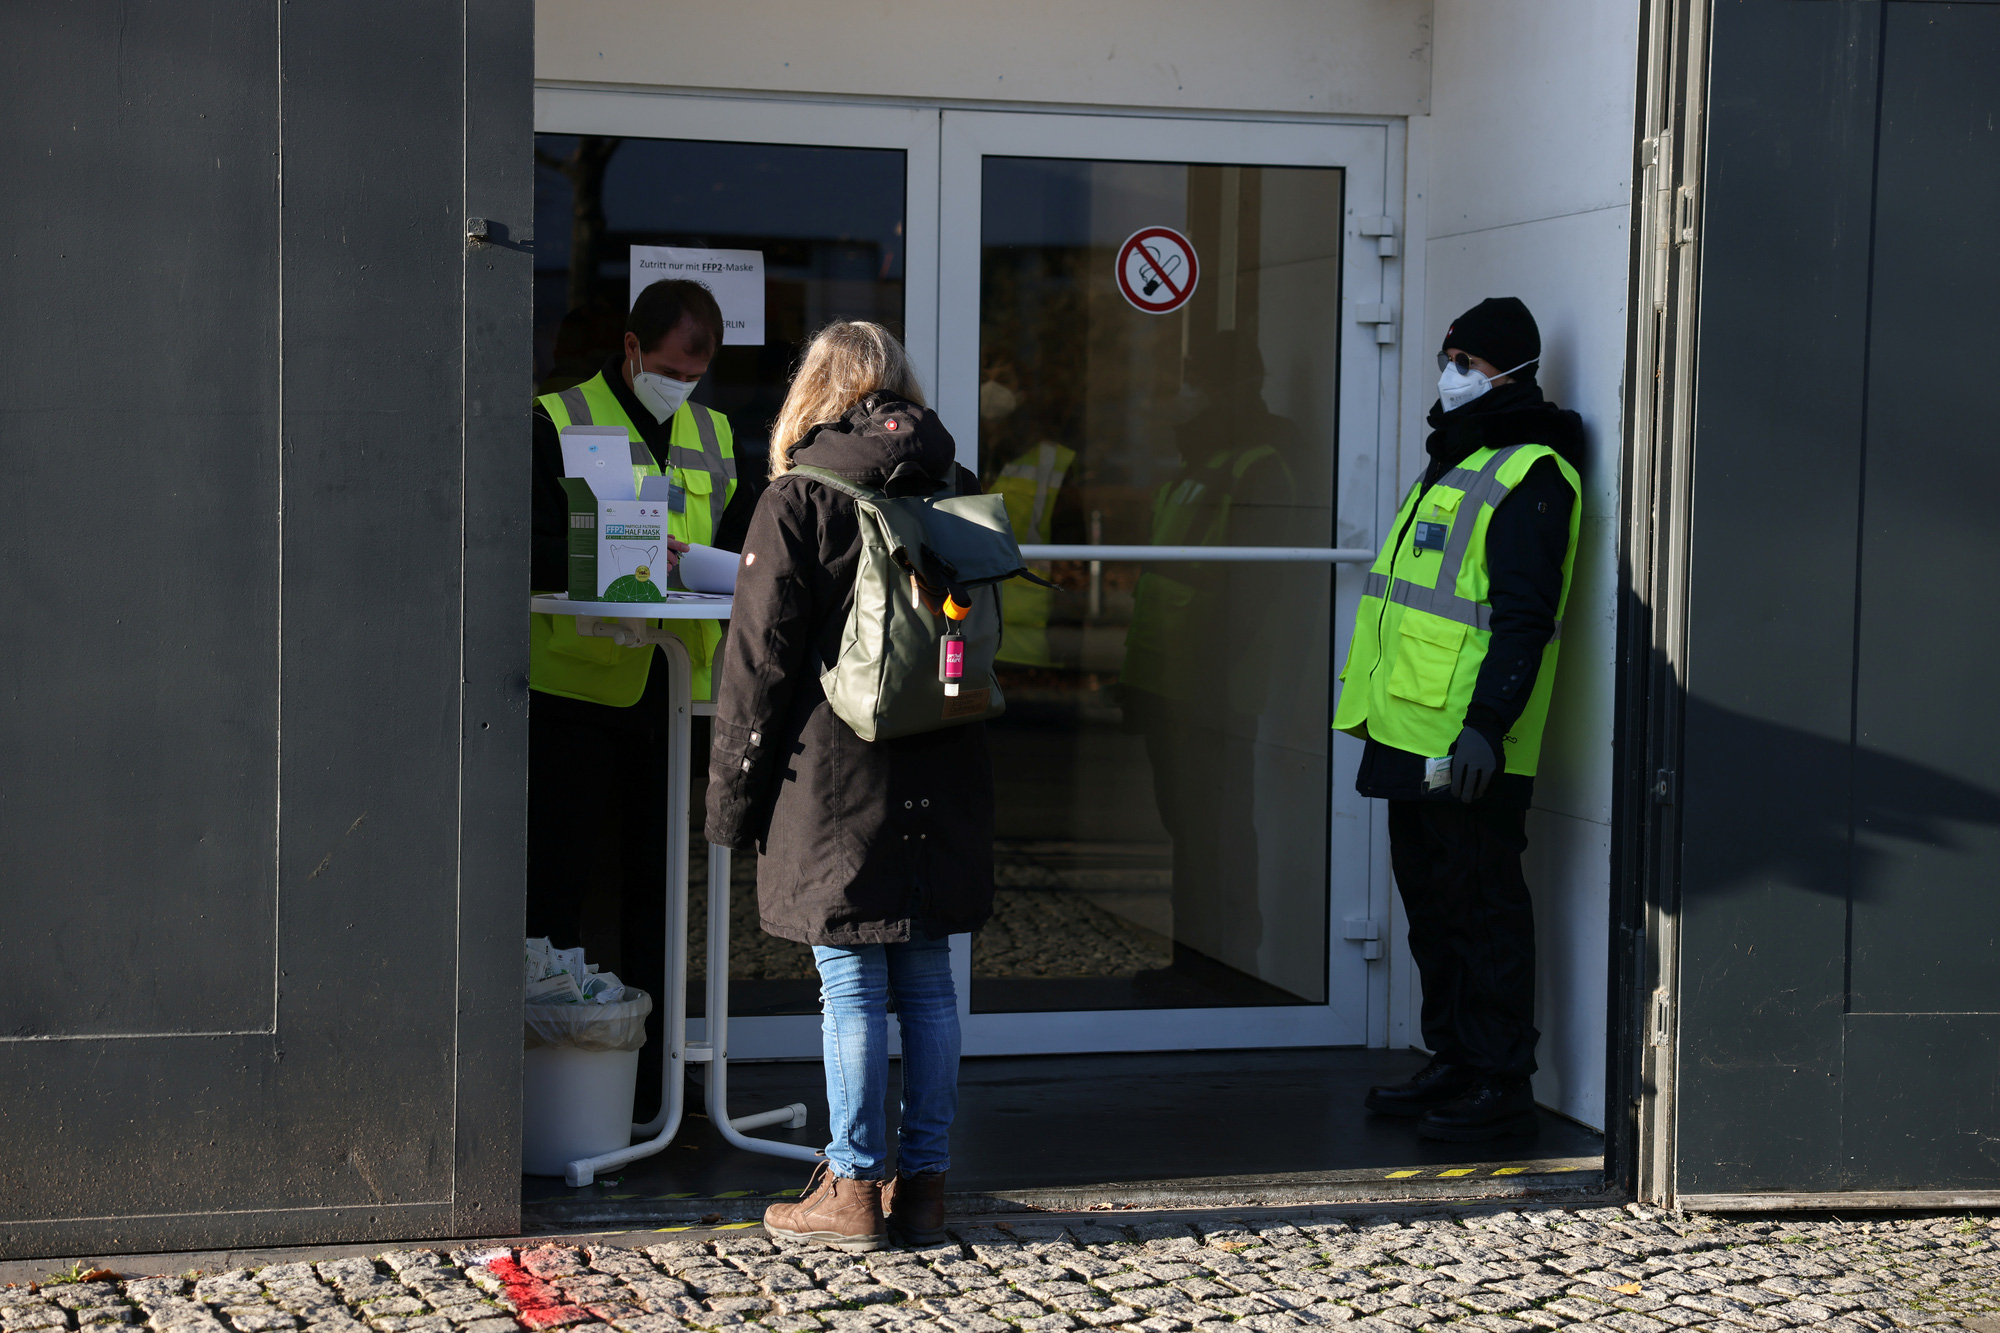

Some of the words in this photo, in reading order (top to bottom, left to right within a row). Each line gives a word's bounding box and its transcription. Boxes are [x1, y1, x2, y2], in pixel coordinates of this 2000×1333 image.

[640, 260, 666, 269] Zutritt
[686, 263, 700, 271] mit
[702, 263, 754, 272] FFP2-Maske
[722, 321, 745, 329] ERLIN
[606, 525, 623, 533] FFP2
